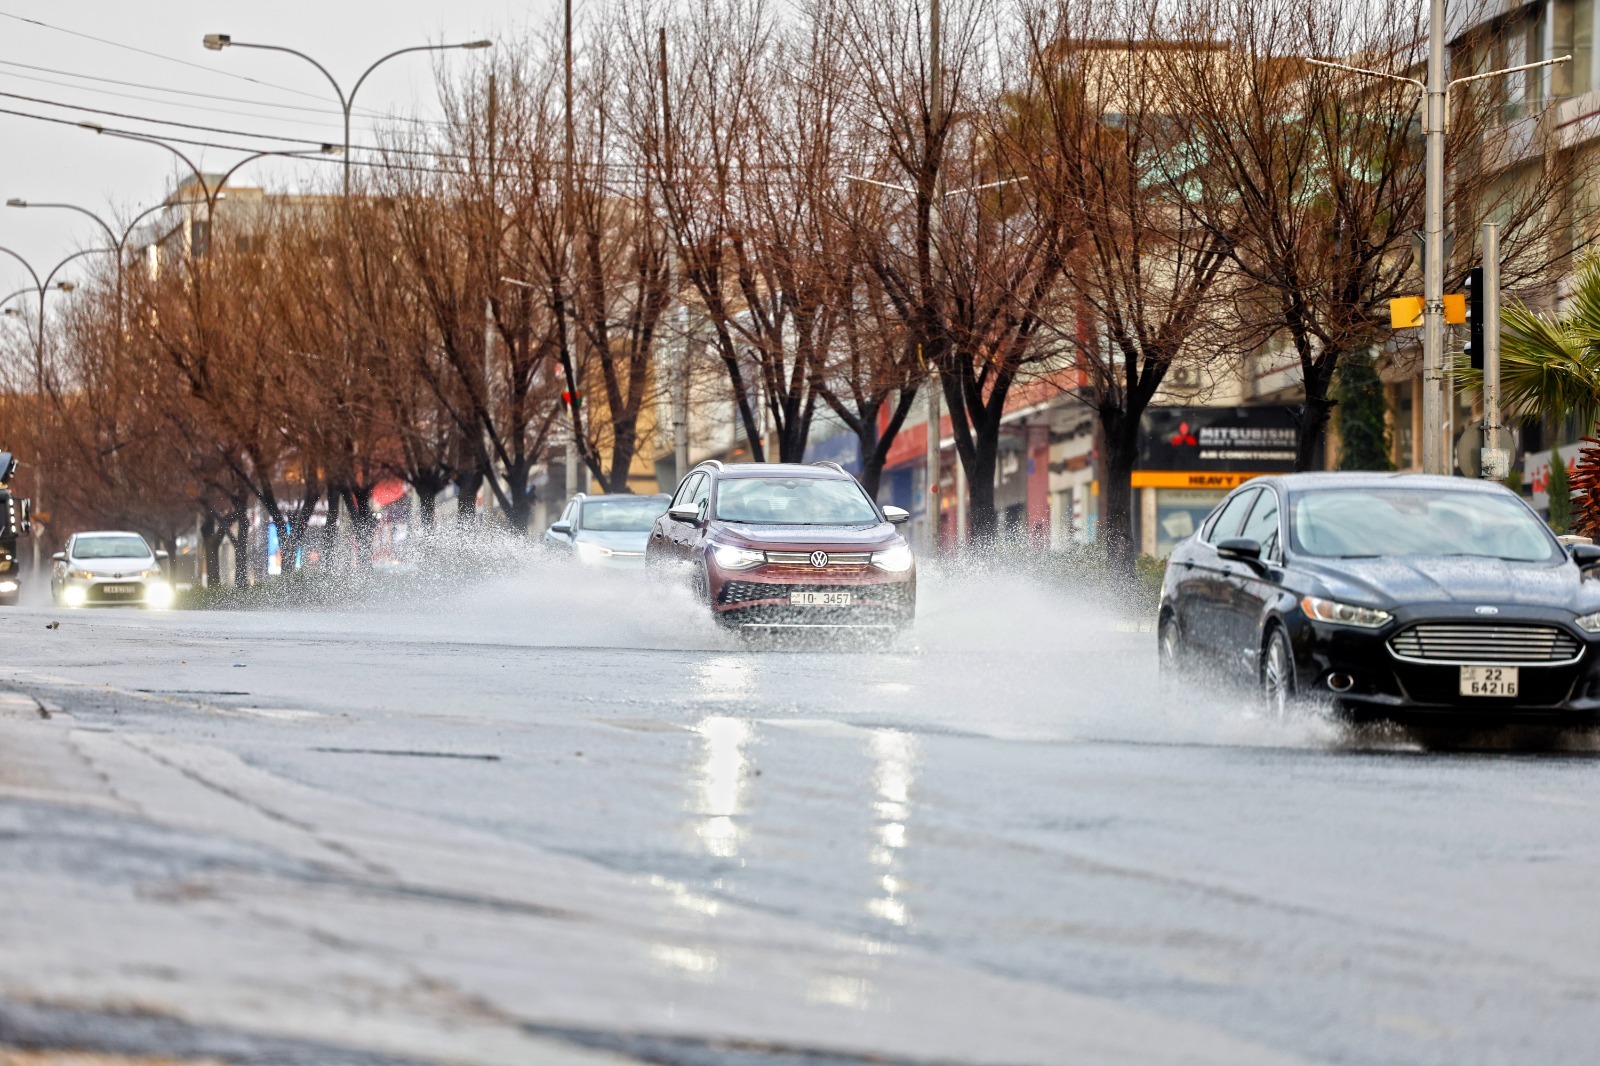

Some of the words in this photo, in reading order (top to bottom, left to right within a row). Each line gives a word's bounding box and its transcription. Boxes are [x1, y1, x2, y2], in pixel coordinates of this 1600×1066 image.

[1200, 428, 1295, 438] MITSUBISHI
[1199, 450, 1217, 459] AIR
[1218, 451, 1297, 460] CONDITIONERS
[1189, 476, 1233, 485] HEAVY
[823, 594, 849, 604] 3457
[1485, 669, 1502, 681] 22
[1471, 682, 1515, 694] 64216
